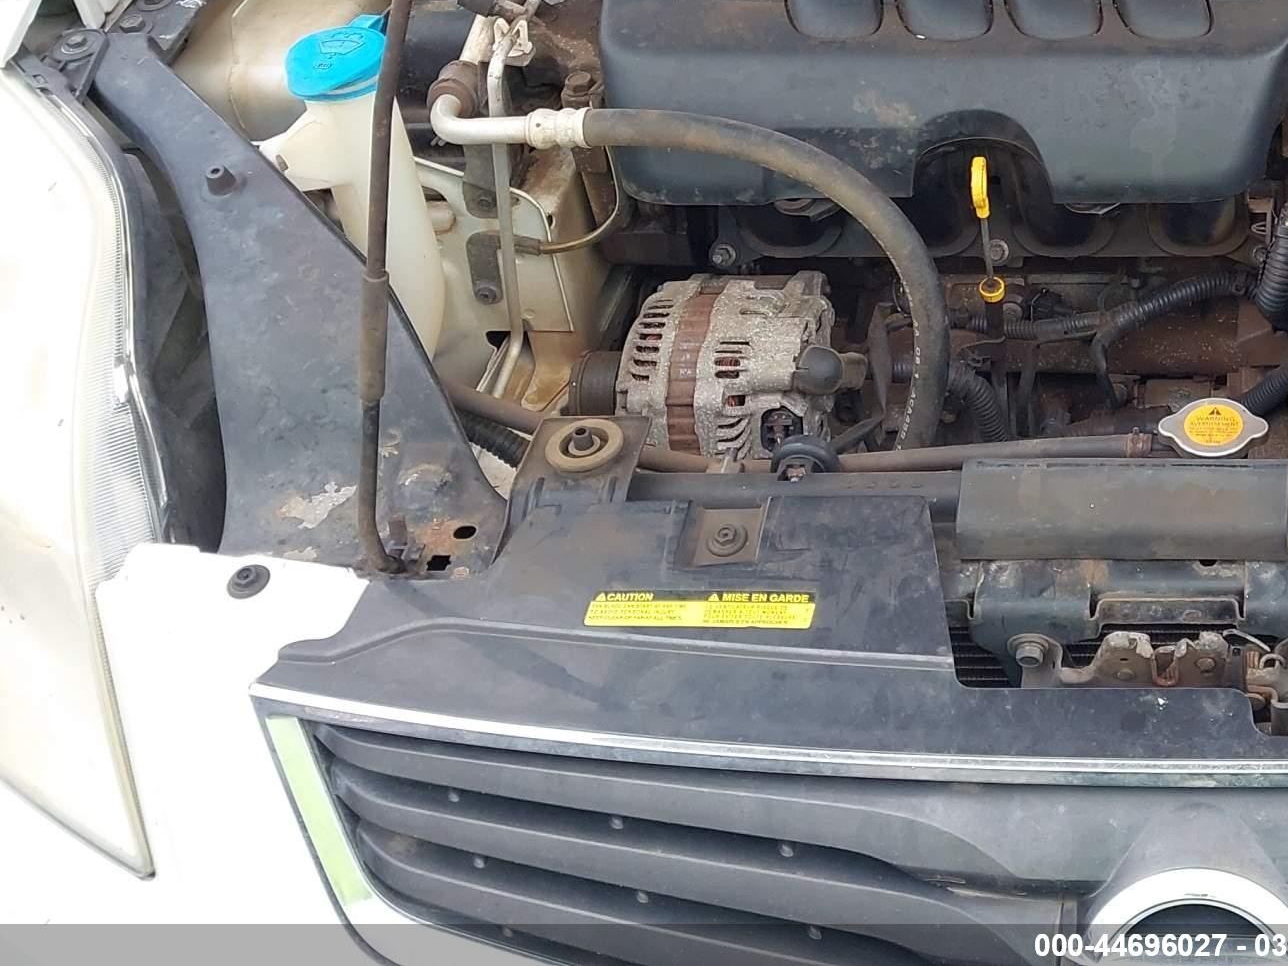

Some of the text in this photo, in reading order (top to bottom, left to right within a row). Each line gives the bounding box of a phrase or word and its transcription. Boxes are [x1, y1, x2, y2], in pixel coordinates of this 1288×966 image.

[607, 592, 810, 603] CAUTION MISE EN GARDE
